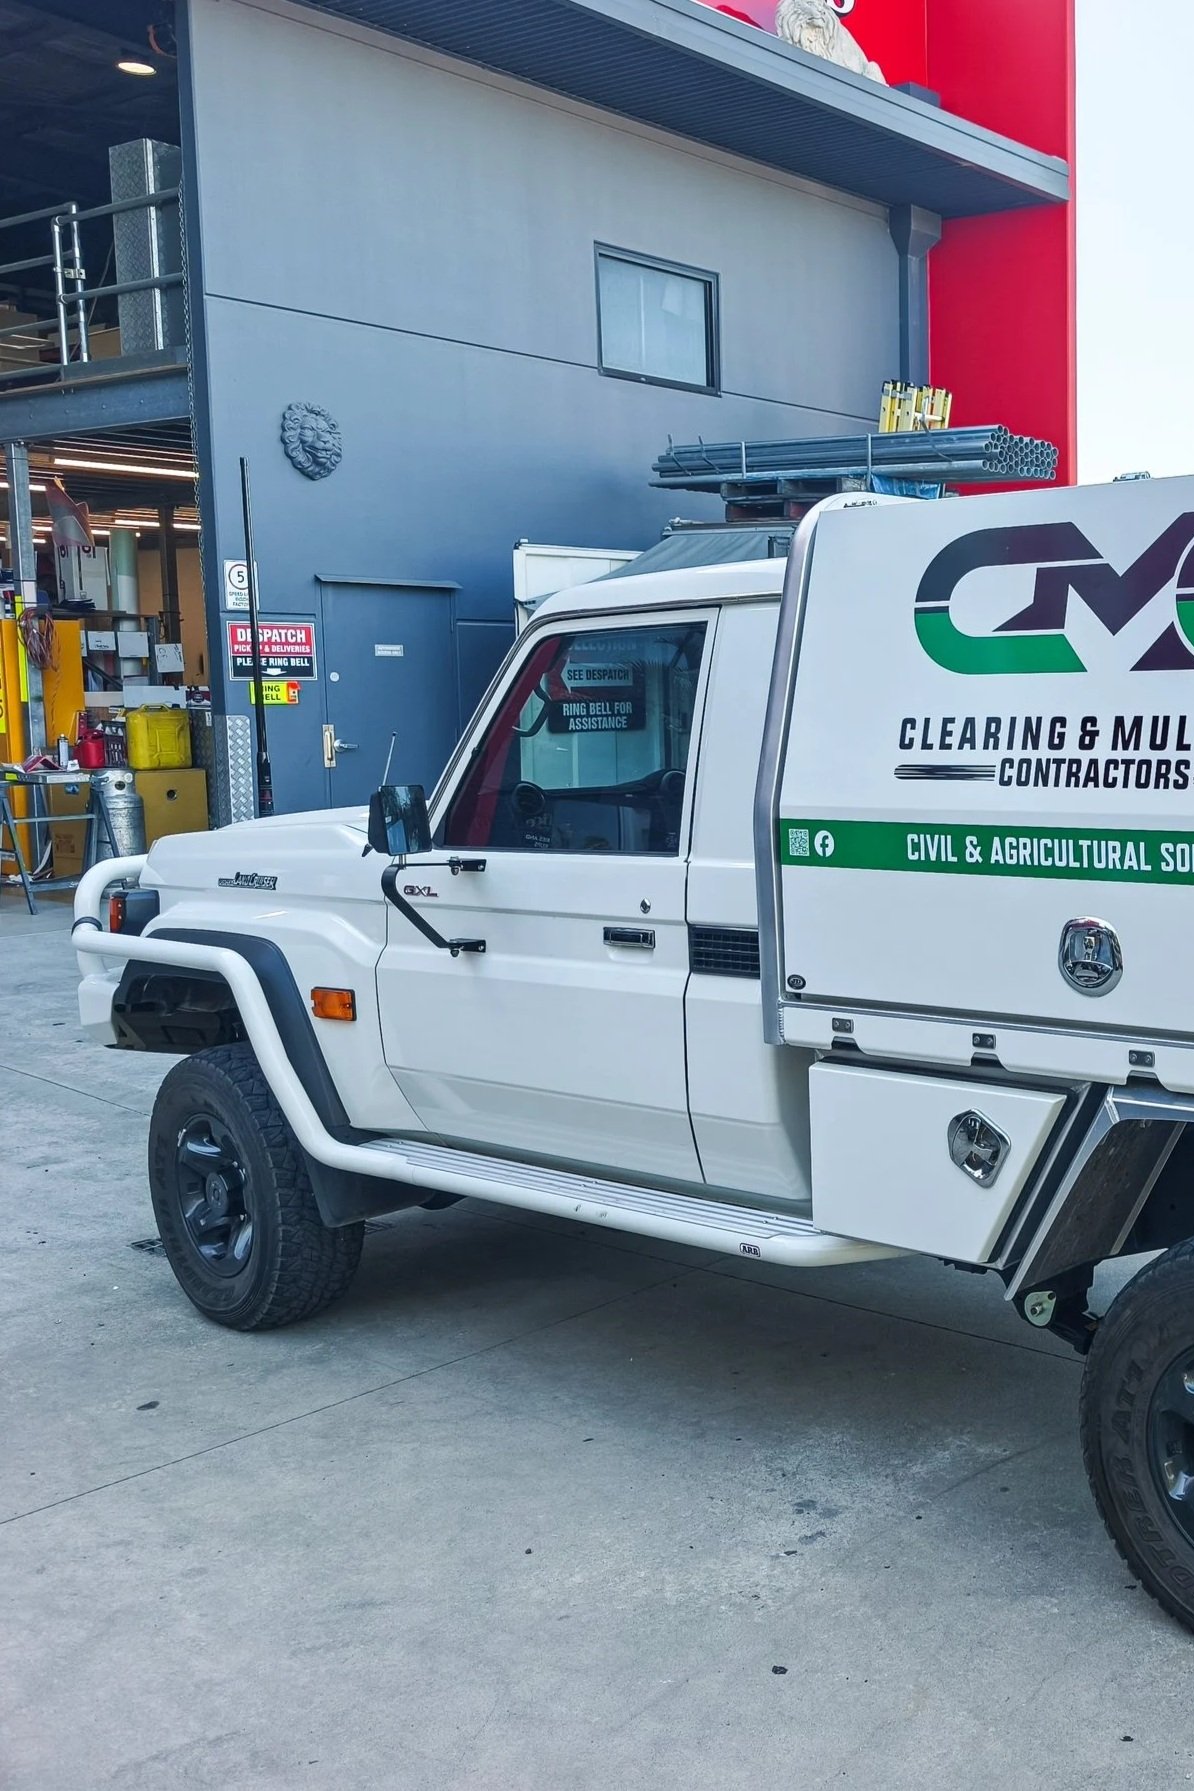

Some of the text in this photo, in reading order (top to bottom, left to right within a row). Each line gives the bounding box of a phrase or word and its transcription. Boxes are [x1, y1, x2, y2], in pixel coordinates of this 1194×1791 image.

[237, 571, 244, 583] 5
[271, 645, 310, 653] DELIVERIES
[237, 657, 310, 667] PLEE RING BELL
[567, 669, 630, 680] SEE DESPATCH
[562, 701, 632, 716] RING BELL FOR
[568, 716, 628, 731] ASSISTANCE
[898, 716, 1067, 751] CLEARING
[1078, 715, 1100, 751] &
[998, 757, 1191, 790] CONTRACTORS
[906, 833, 958, 863] CIVIL
[965, 835, 983, 864] &
[990, 836, 1152, 871] AGRICULTURAL
[403, 885, 439, 898] GXL
